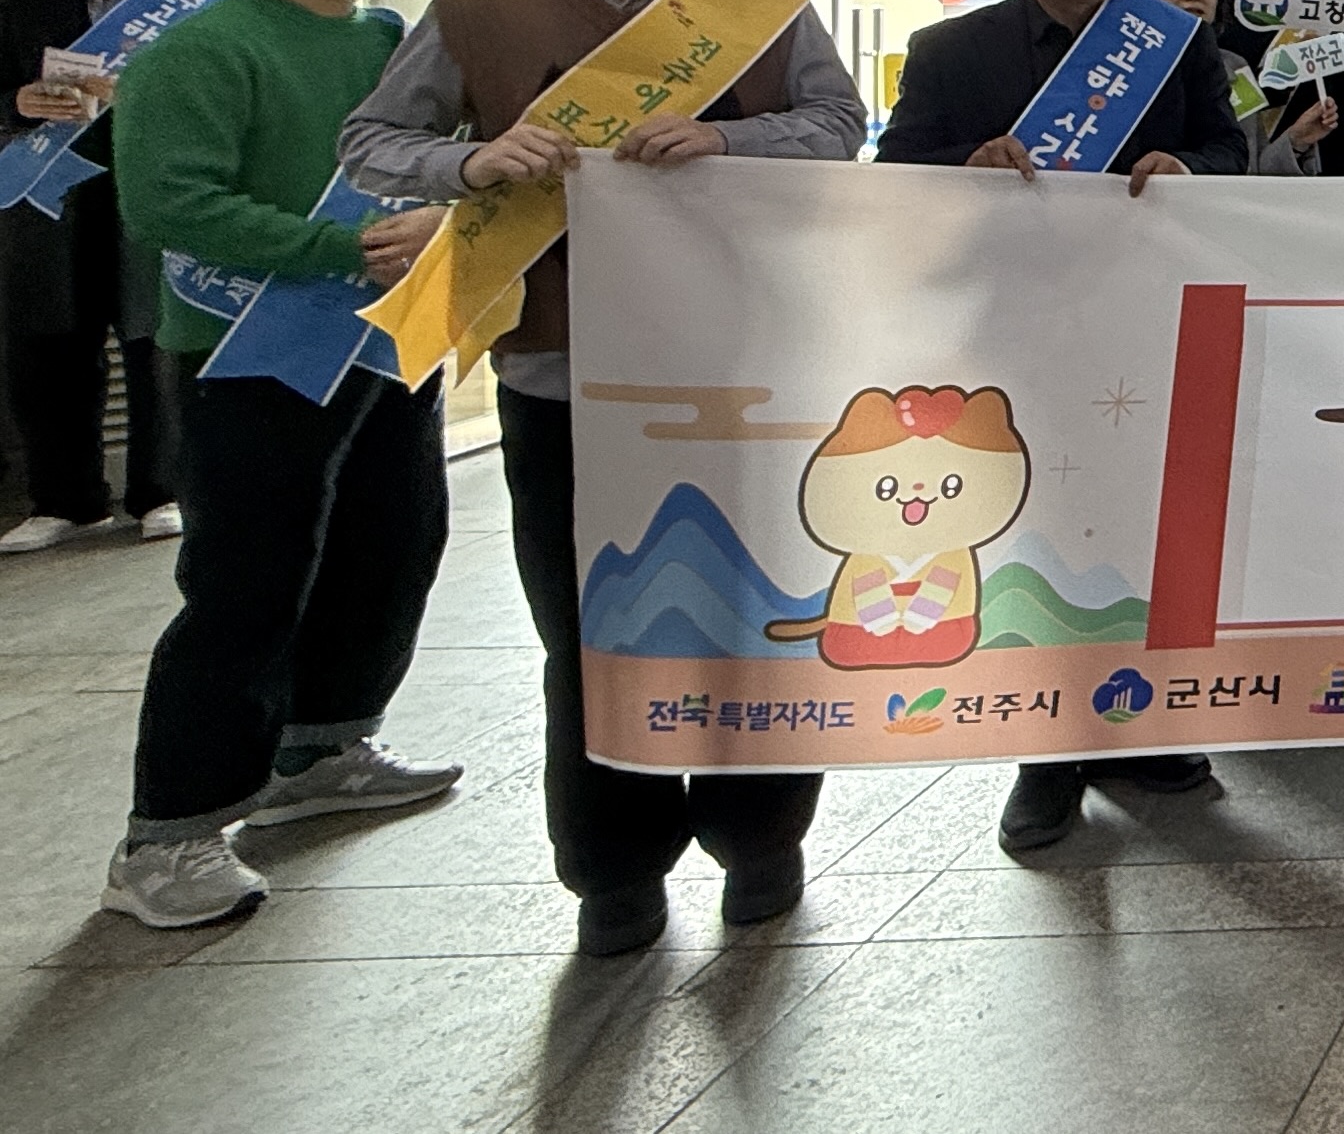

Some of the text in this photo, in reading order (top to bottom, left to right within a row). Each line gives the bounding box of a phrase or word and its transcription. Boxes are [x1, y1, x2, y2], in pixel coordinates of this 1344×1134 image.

[1119, 12, 1167, 50] 전주
[1299, 42, 1344, 75] 장수군
[648, 693, 856, 733] 전북특별자치도
[952, 690, 1062, 725] 전주시
[1165, 673, 1282, 710] 군산시
